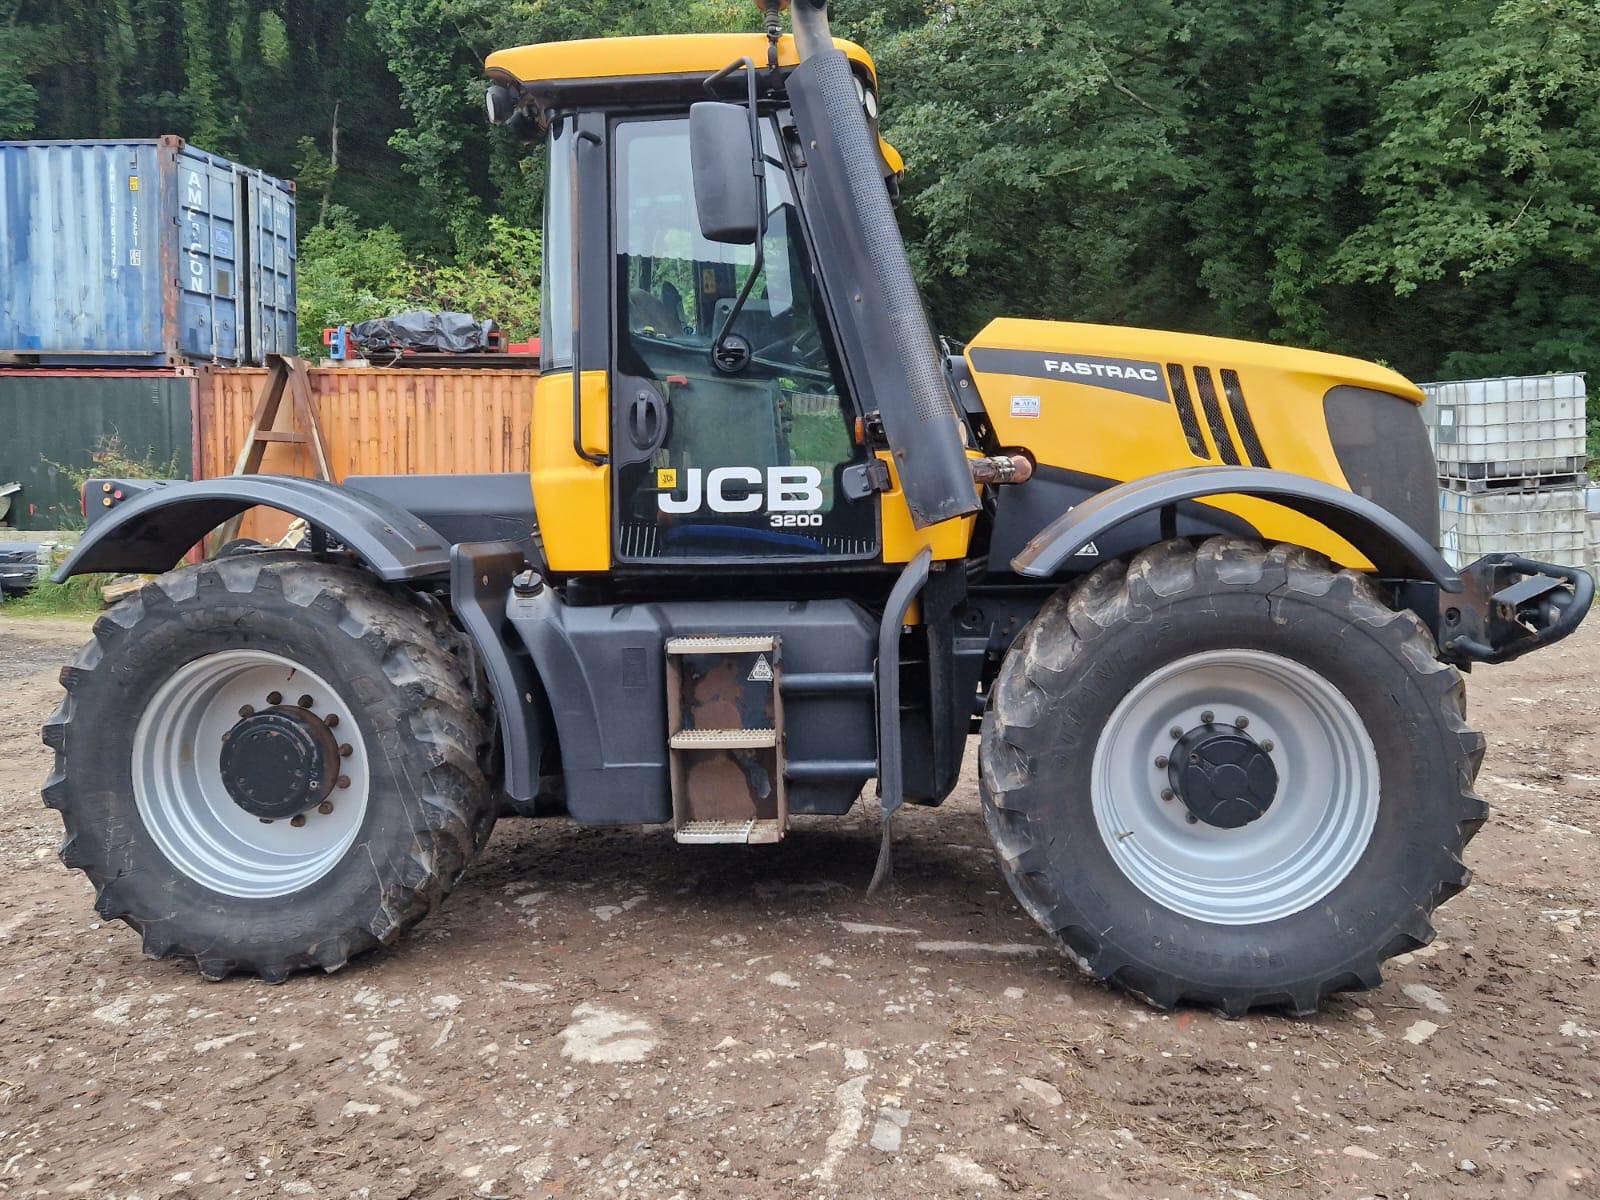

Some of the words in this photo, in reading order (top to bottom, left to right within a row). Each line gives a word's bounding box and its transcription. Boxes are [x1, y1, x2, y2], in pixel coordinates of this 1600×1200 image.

[1043, 359, 1158, 381] FASTRAC
[657, 465, 823, 514] JCB
[770, 514, 823, 527] 3200
